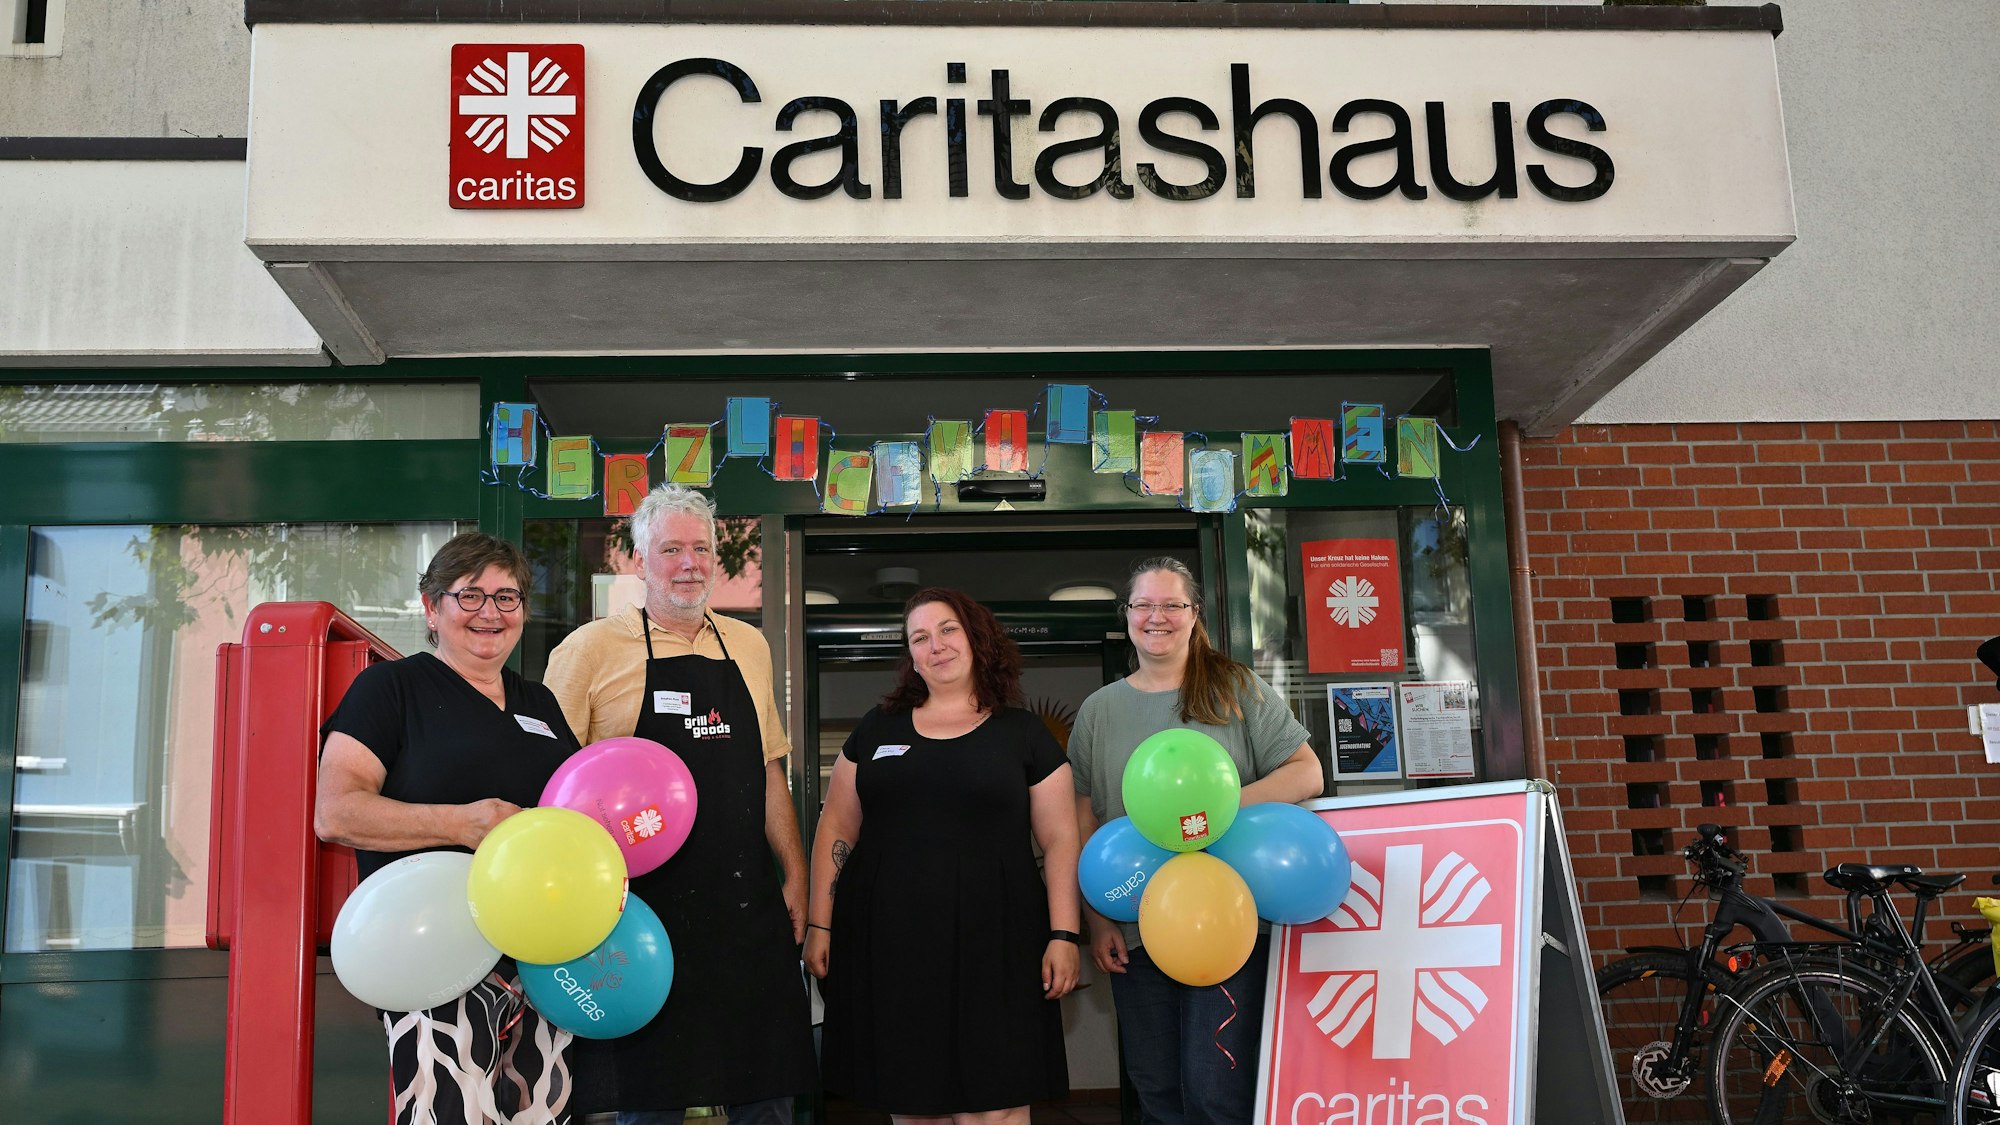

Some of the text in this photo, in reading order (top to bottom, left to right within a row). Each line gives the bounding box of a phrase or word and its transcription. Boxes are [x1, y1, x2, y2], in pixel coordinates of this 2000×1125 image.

[632, 57, 1616, 203] Caritashaus
[457, 170, 577, 201] caritas
[684, 715, 708, 730] grill
[692, 722, 731, 739] goods
[620, 819, 636, 846] caritas
[1184, 833, 1208, 842] caritas
[1104, 870, 1146, 902] caritas
[553, 967, 606, 1022] caritas
[1291, 1076, 1490, 1125] caritas
